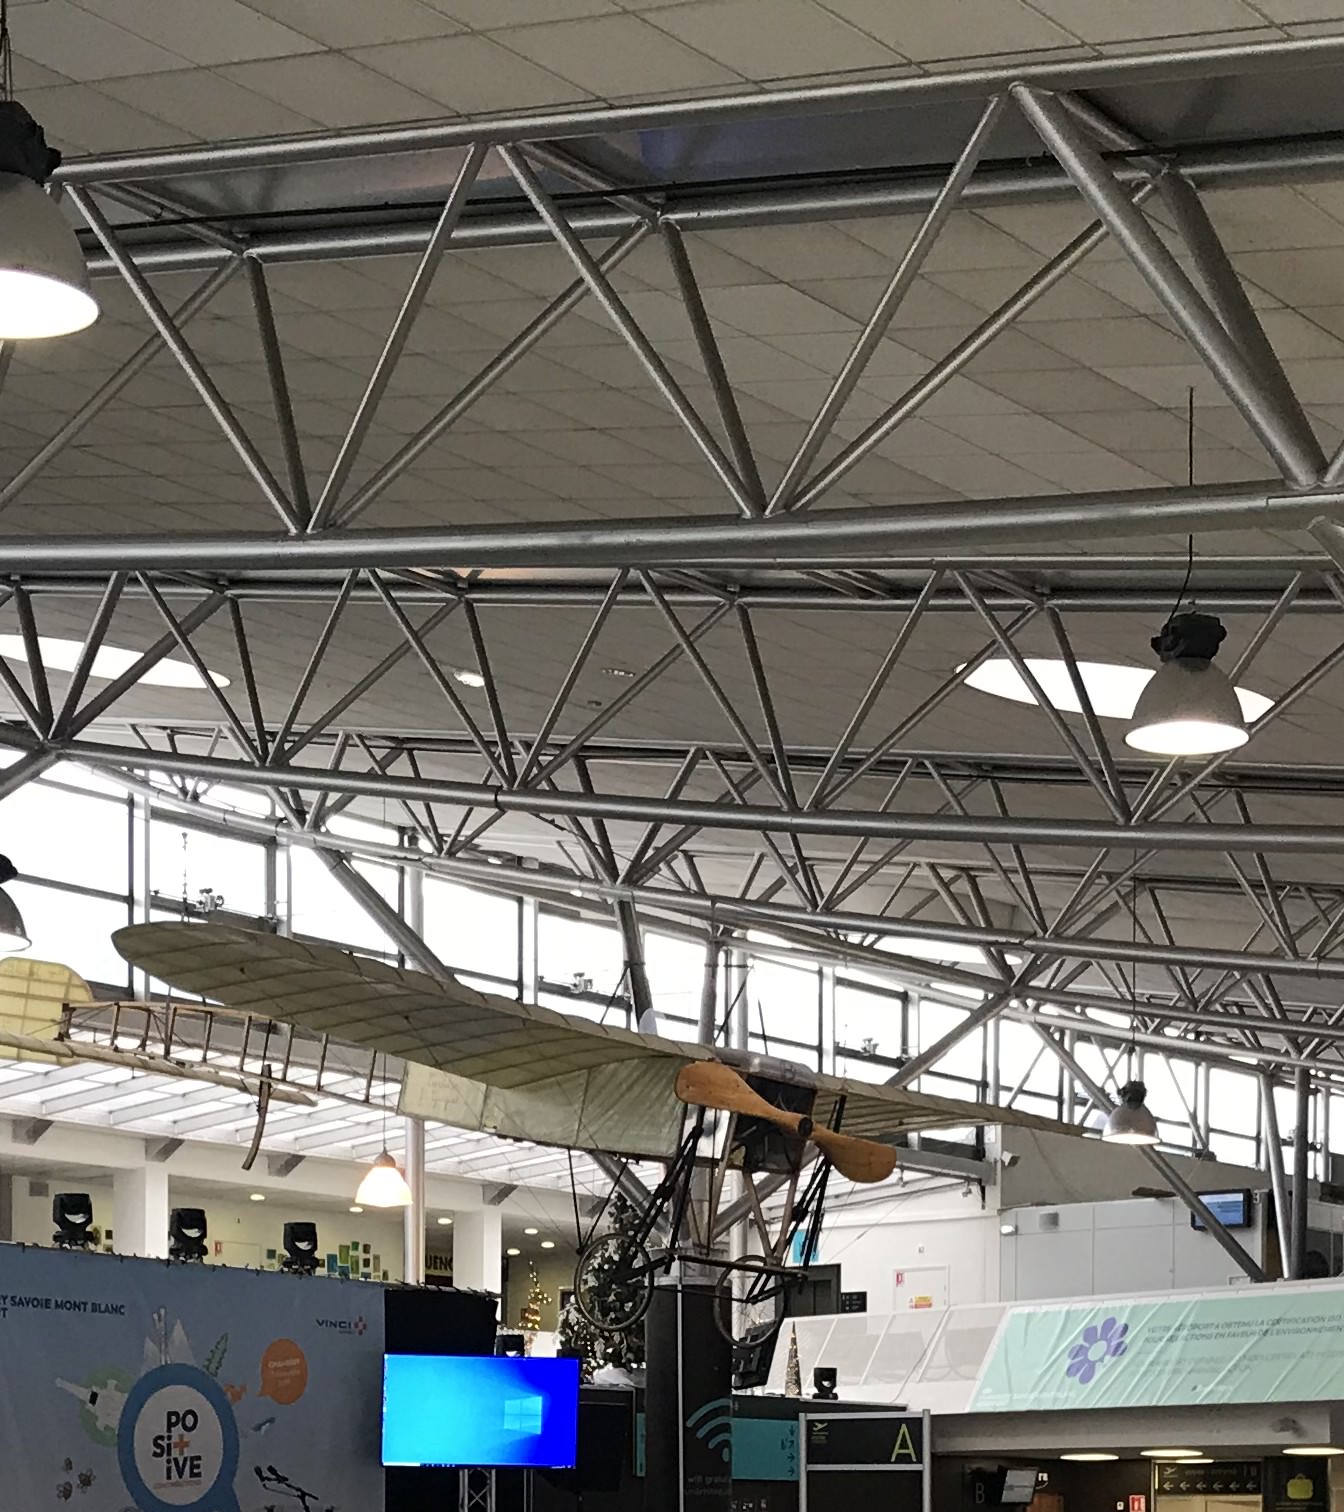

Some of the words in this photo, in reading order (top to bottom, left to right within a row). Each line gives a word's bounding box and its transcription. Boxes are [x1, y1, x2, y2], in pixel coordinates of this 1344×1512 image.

[10, 1296, 51, 1310] SAVOIE
[55, 1299, 88, 1313] MONT
[91, 1303, 126, 1316] BLANC
[316, 1319, 352, 1329] VINCI
[166, 1409, 198, 1433] PO
[891, 1423, 917, 1463] A
[976, 1482, 985, 1504] B
